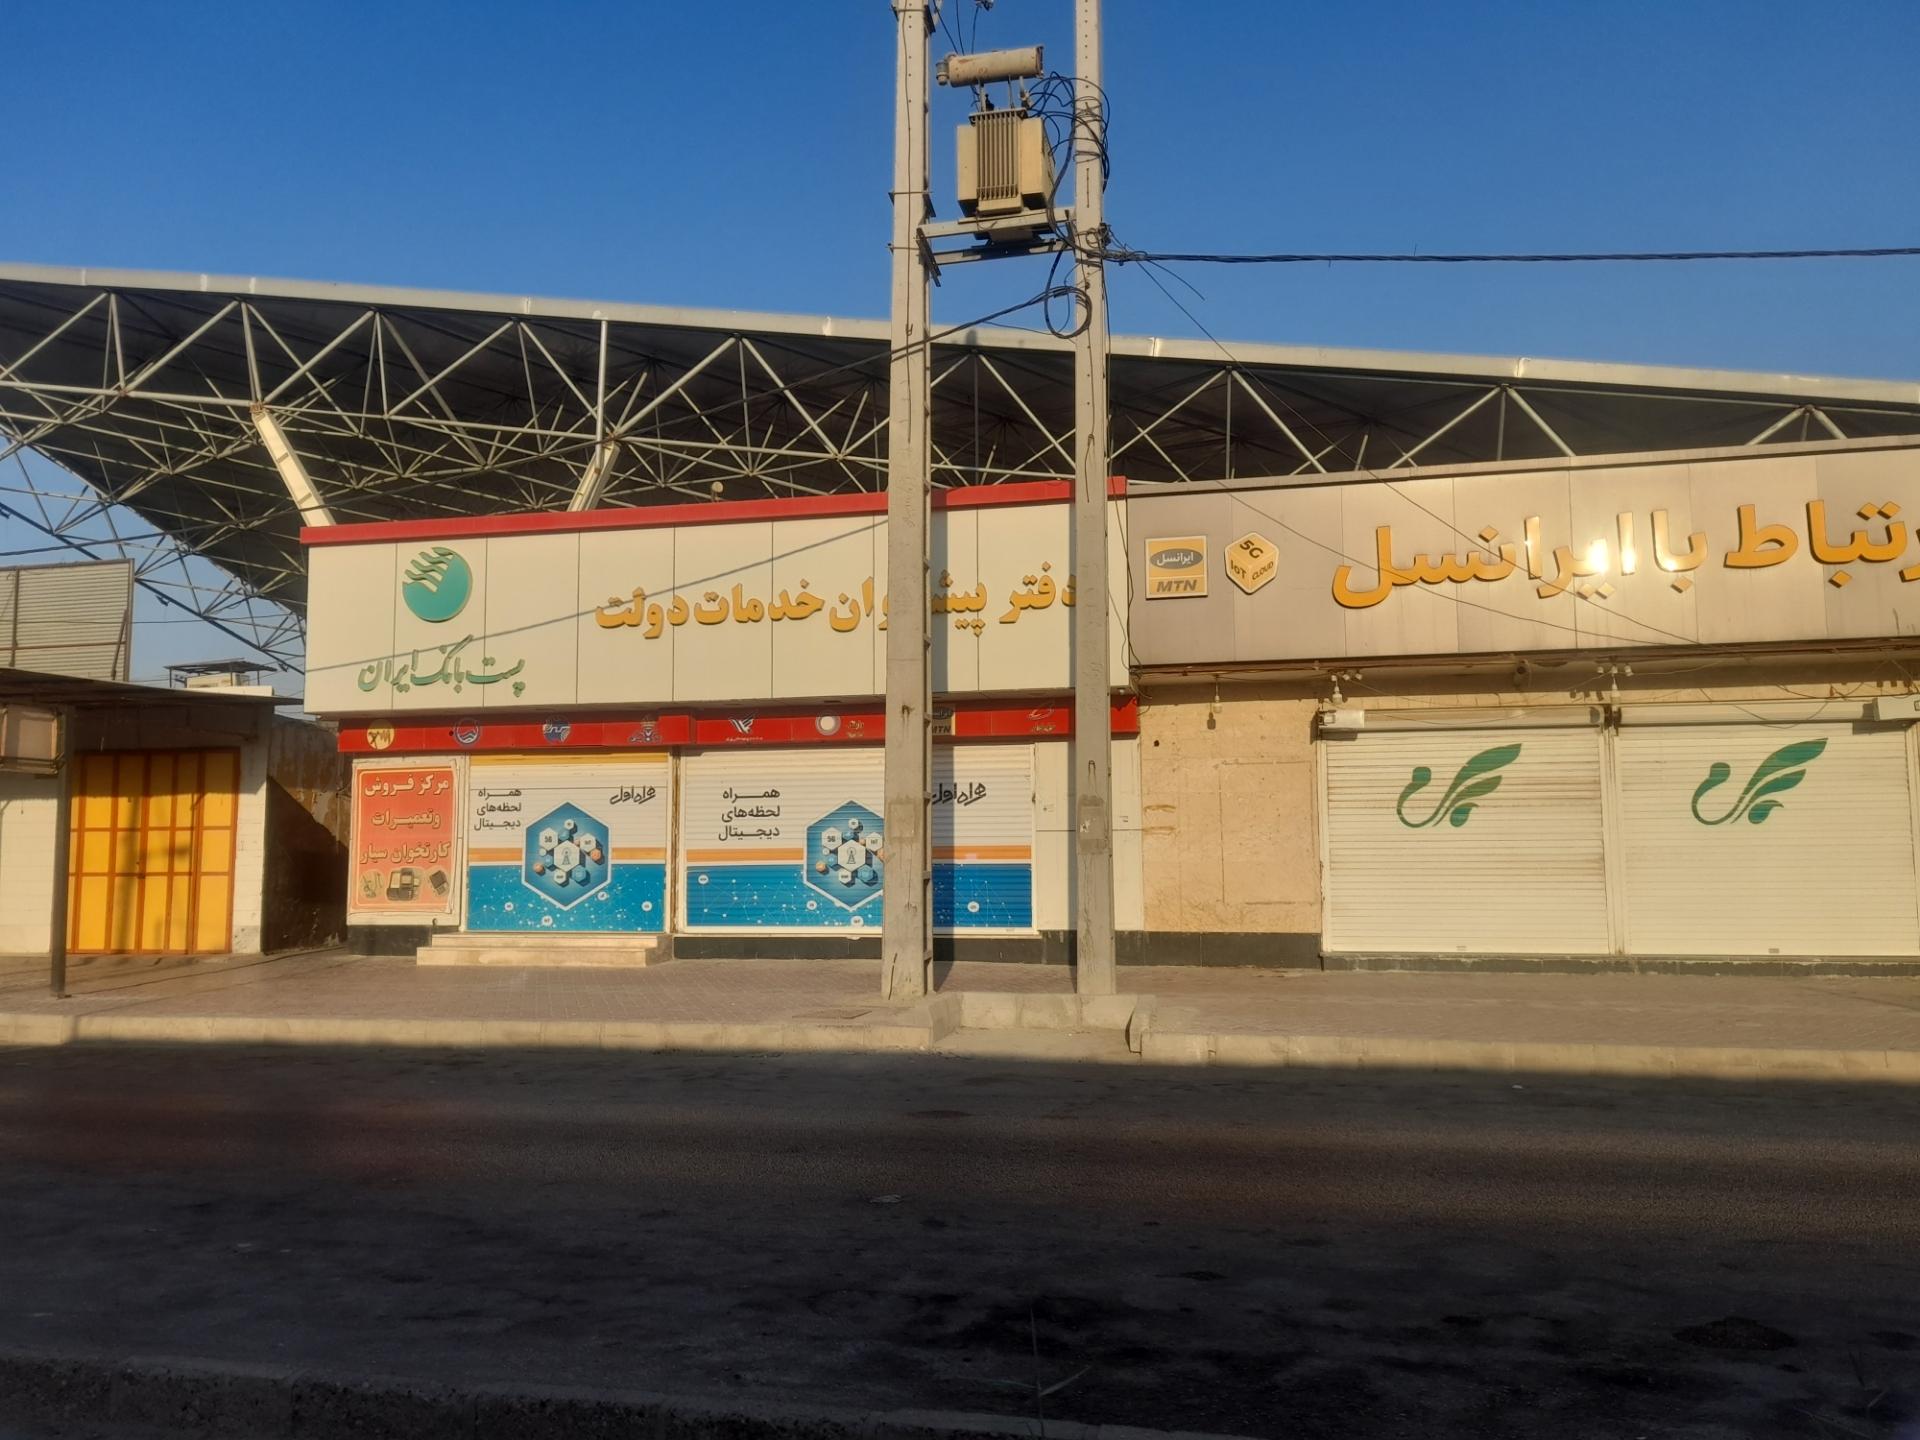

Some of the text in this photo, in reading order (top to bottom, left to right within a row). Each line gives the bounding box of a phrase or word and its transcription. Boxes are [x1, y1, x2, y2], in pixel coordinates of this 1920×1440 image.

[1156, 551, 1194, 567] ایرانسل
[1331, 511, 1636, 609] ایرانسل
[1651, 509, 1708, 593] با
[1251, 560, 1274, 580] CLOUD
[1156, 579, 1197, 593] MTN
[595, 586, 689, 639] دولت
[694, 579, 825, 625] خدمات
[828, 569, 988, 637] پیشان
[358, 634, 526, 697] پست بانک ایران
[364, 774, 449, 796] مرکز فروش
[478, 787, 522, 800] همراه
[722, 787, 781, 803] همراه
[474, 818, 521, 831] دیجیتال
[718, 824, 780, 842] دیجیتال
[360, 840, 451, 864] کارتخوان سیار
